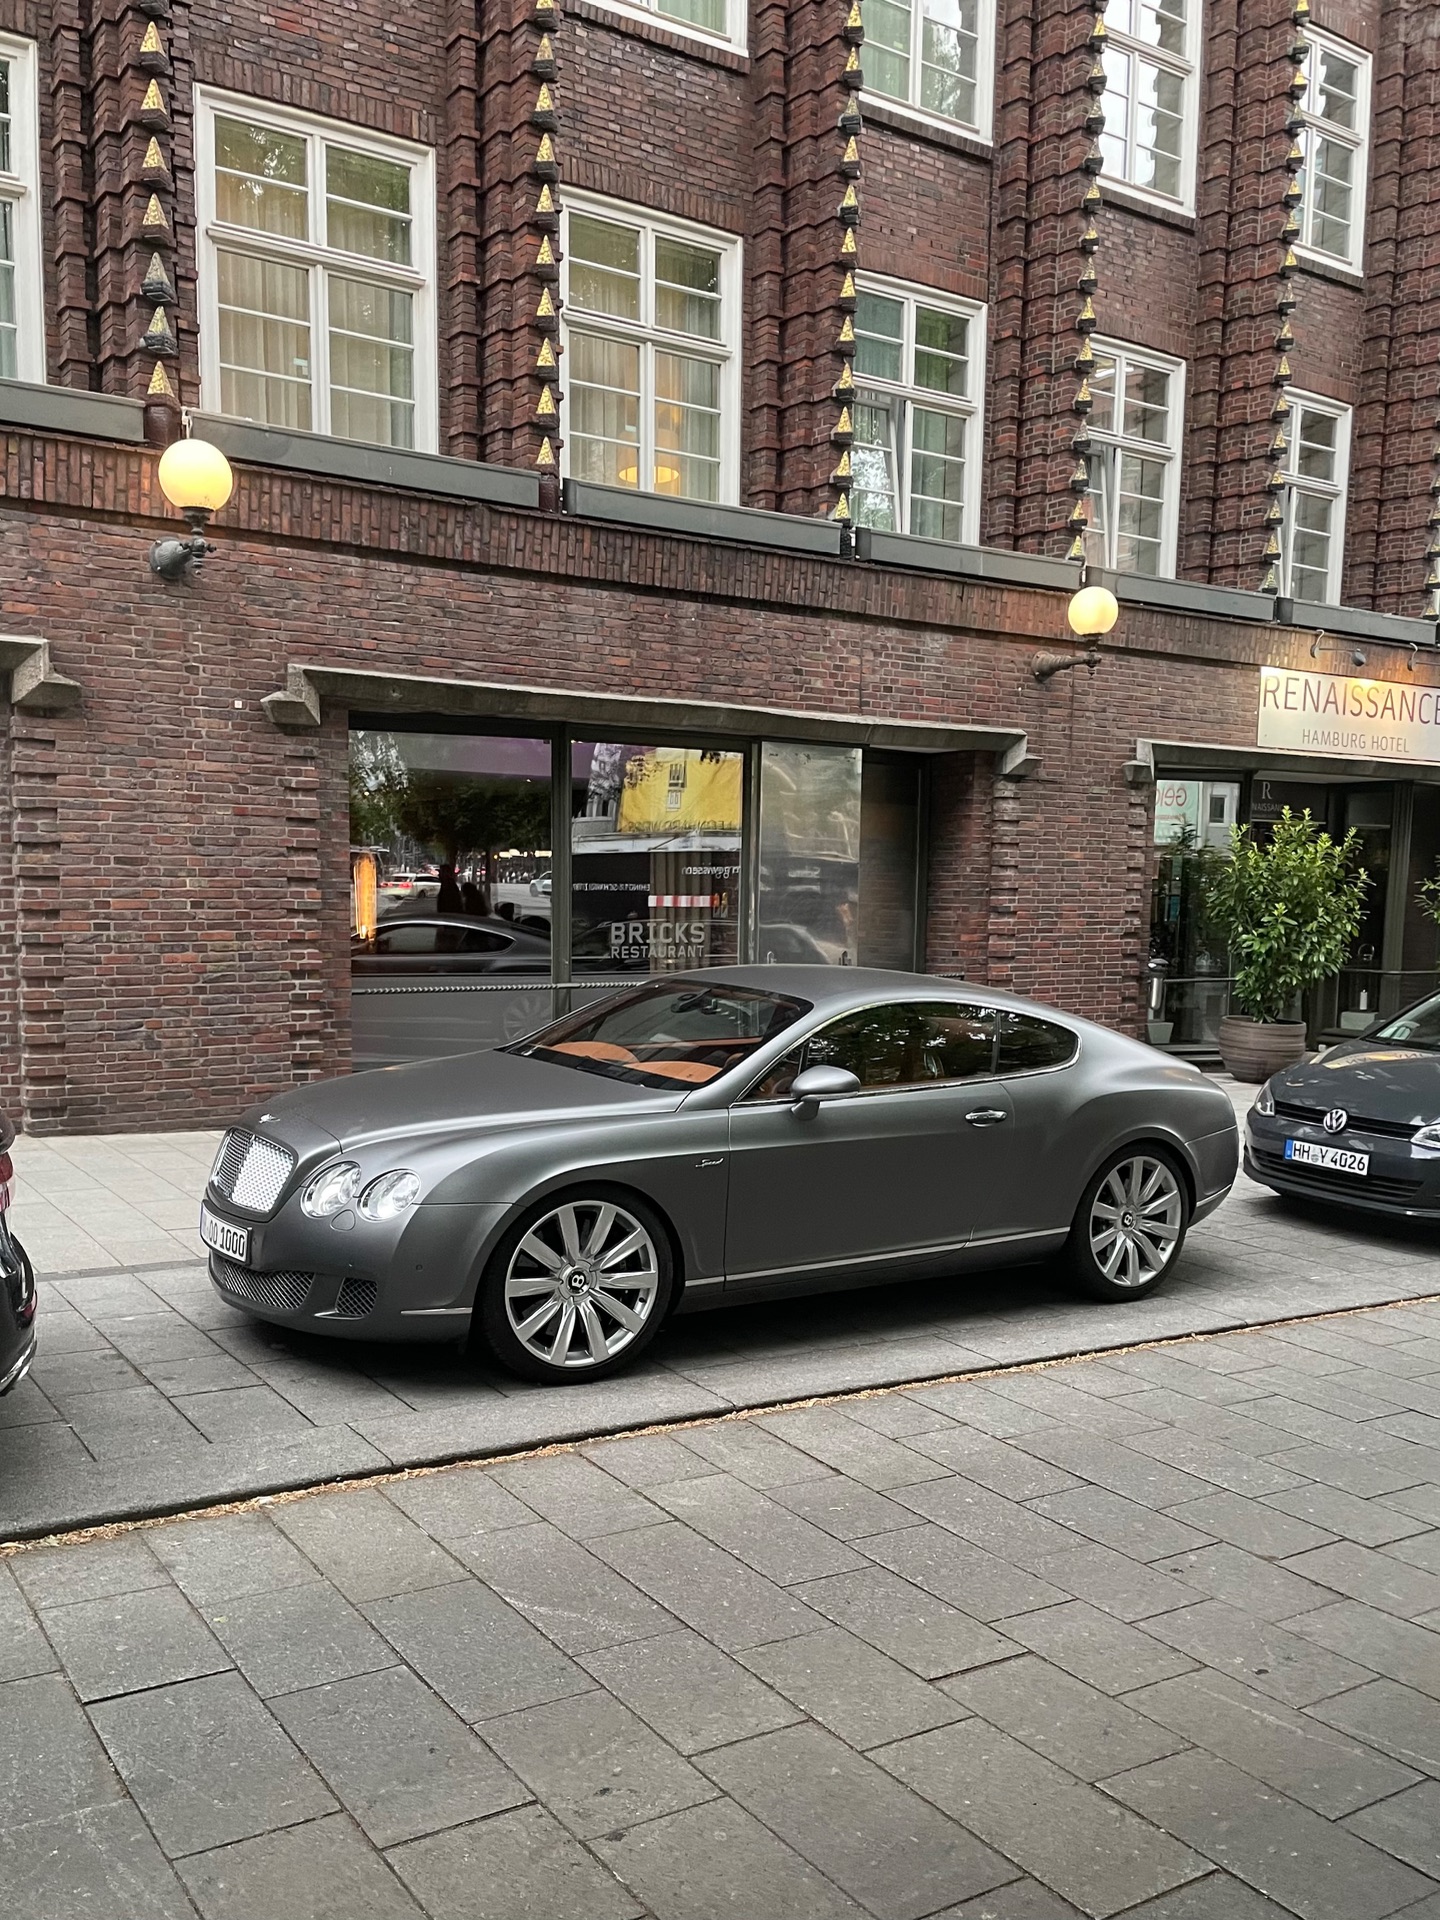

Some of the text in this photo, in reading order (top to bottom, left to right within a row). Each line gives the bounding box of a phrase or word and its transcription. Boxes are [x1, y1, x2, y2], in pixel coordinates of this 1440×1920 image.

[1302, 728, 1410, 754] HAMBURG HOTEL
[1262, 781, 1272, 800] R
[611, 922, 705, 944] BRICKS
[611, 945, 705, 959] RESTAURANT
[1294, 1142, 1366, 1171] HH Y 4026
[220, 1226, 246, 1258] 1000
